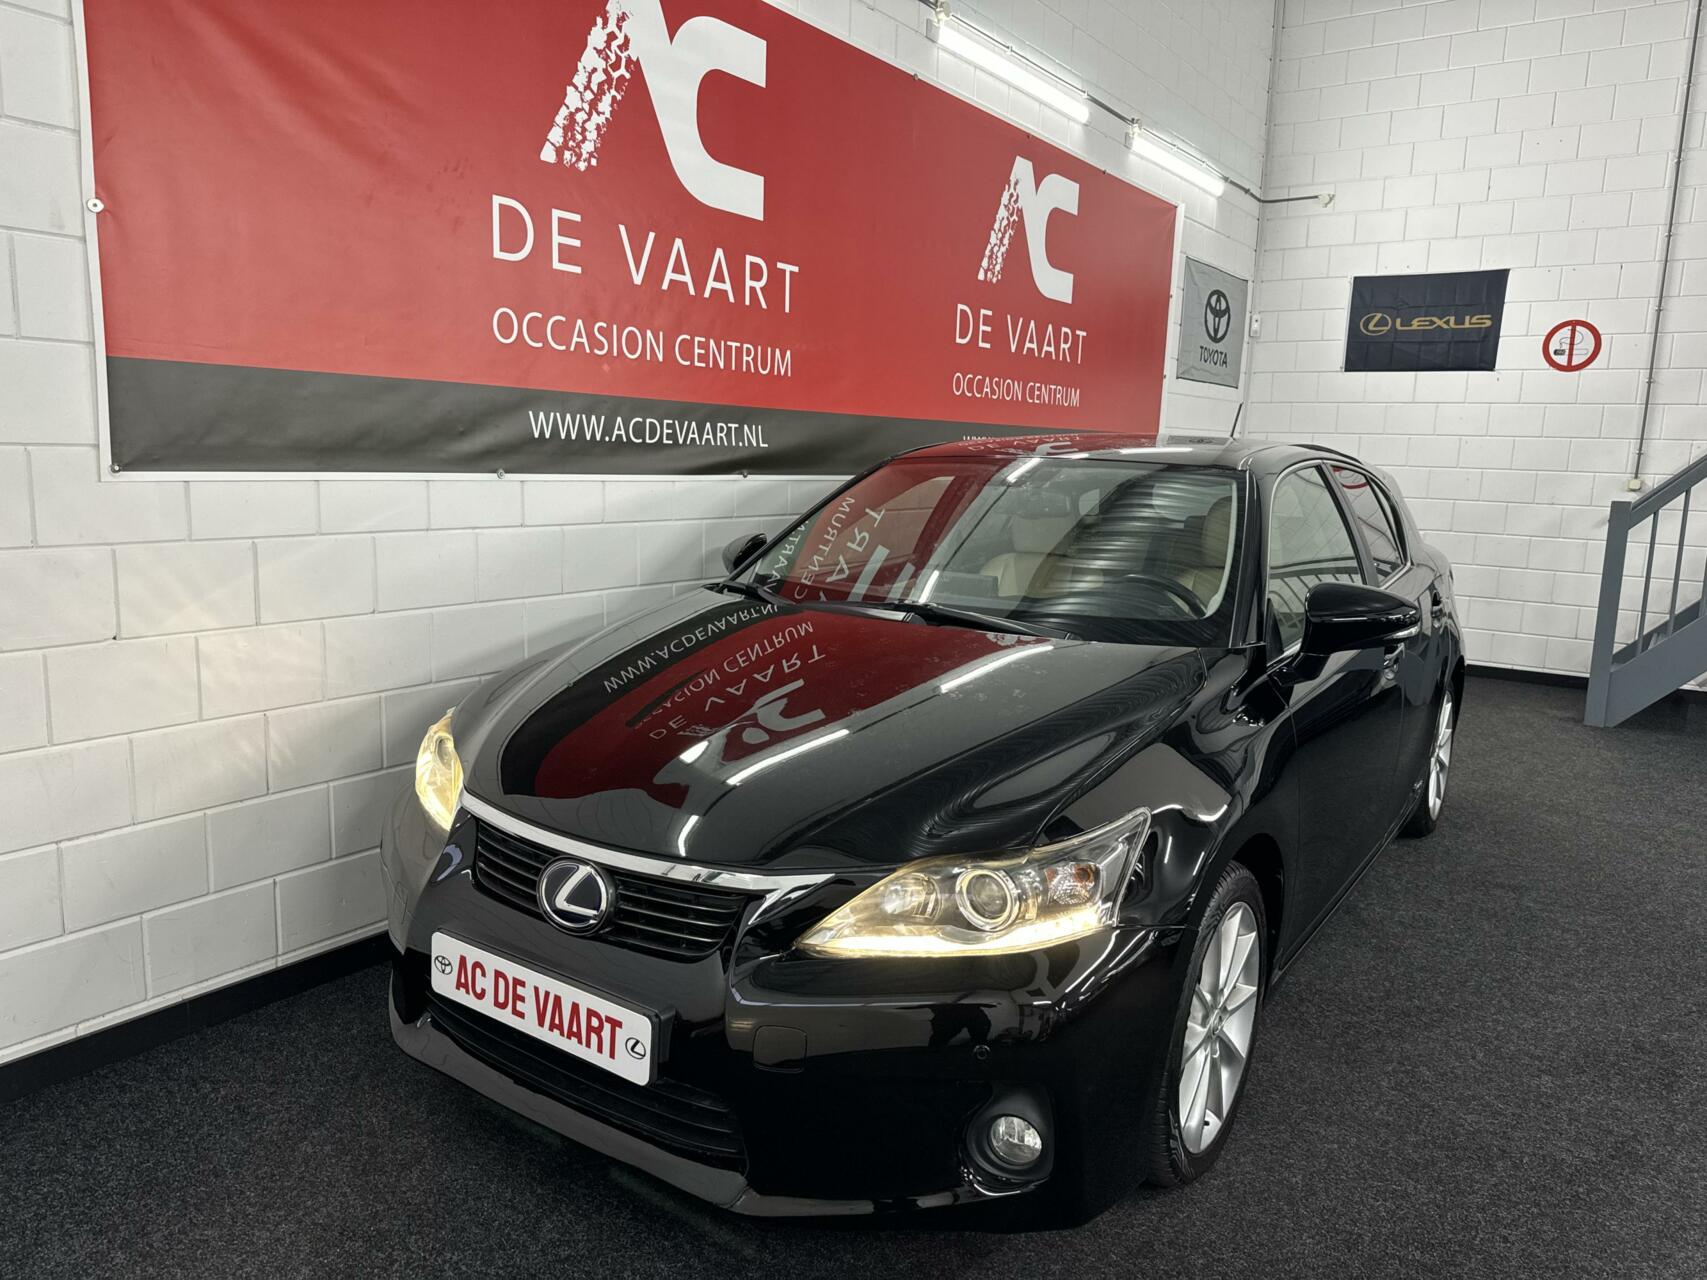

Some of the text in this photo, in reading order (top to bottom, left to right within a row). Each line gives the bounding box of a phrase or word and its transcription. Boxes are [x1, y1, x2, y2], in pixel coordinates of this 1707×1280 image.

[492, 194, 799, 313] DE VAART
[492, 307, 792, 377] OCCASION CENTRUM
[955, 303, 1087, 364] DE VAART
[1395, 314, 1493, 331] LEXUS
[1199, 345, 1228, 368] TOYOTA
[952, 372, 1081, 407] OCCASION CENTRUM
[528, 411, 769, 447] WWW.ACDEVAART.NL
[455, 954, 623, 1060] AC DE VAART
